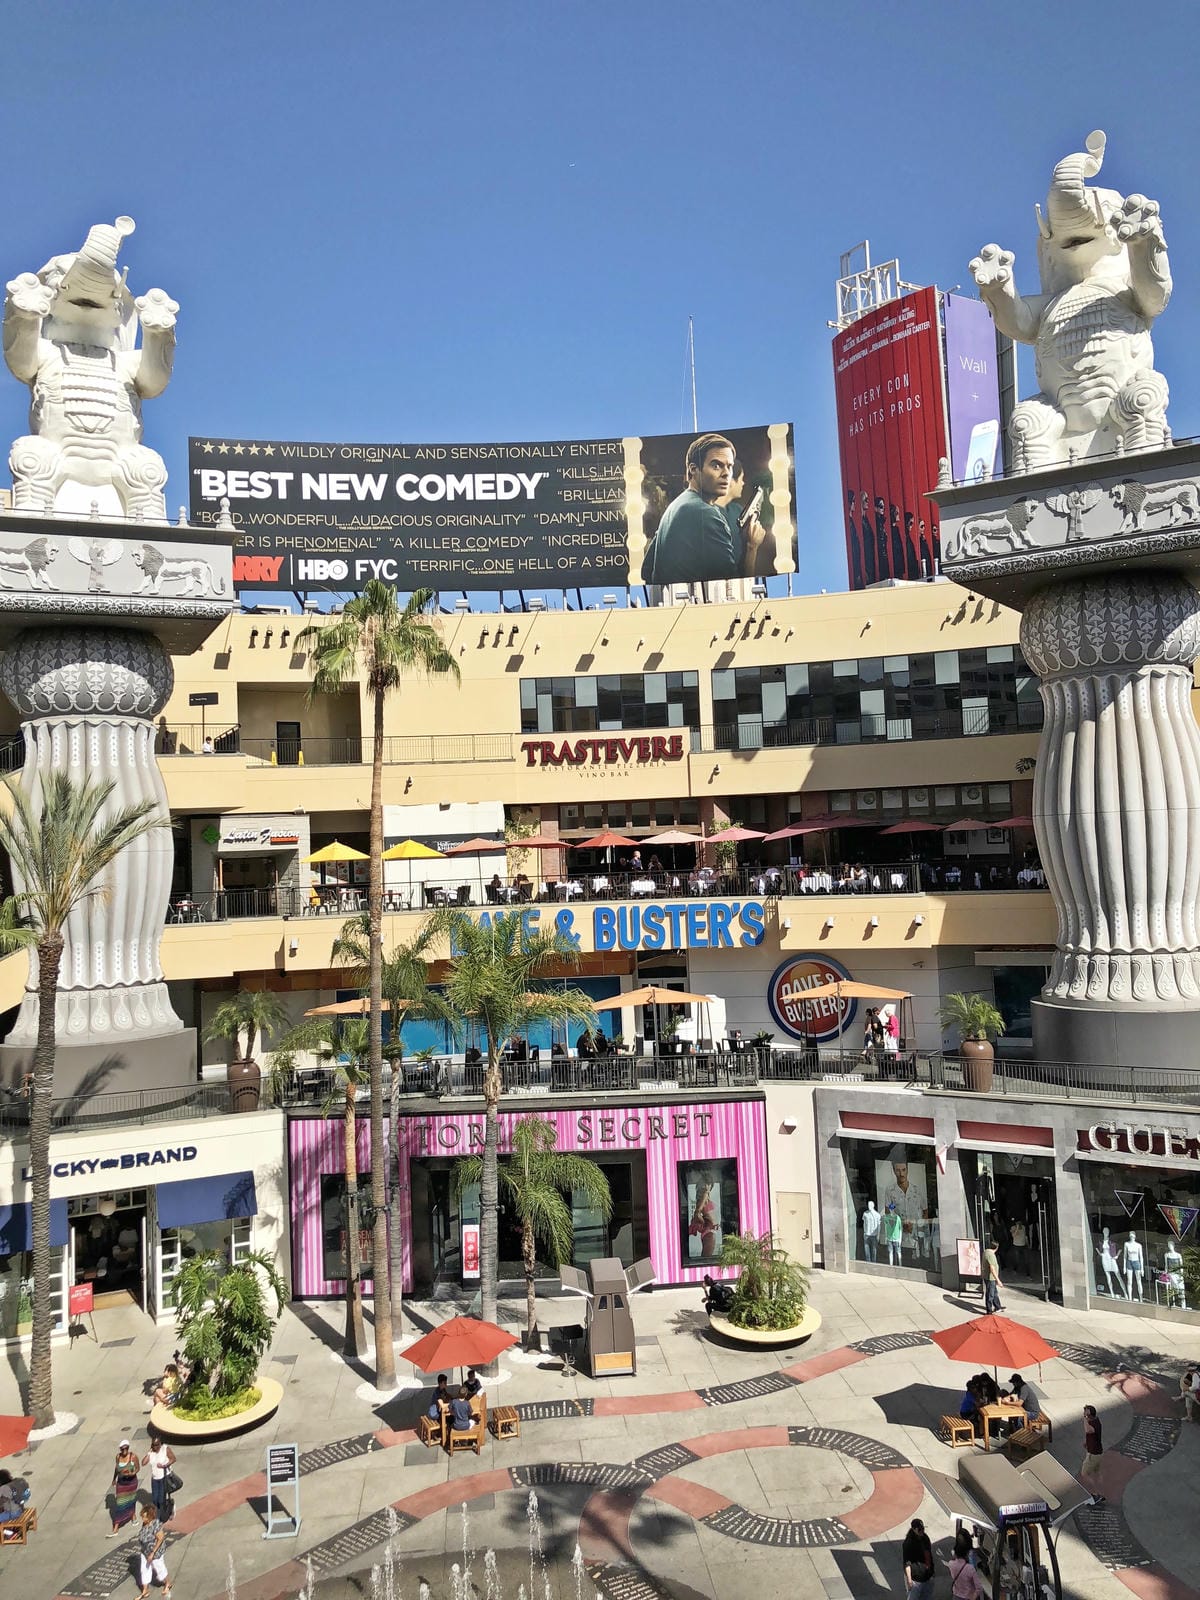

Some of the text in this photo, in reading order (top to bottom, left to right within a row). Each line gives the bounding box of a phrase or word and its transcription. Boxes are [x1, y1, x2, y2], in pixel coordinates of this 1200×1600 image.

[912, 321, 931, 334] CARTER
[959, 355, 987, 375] Wall
[853, 373, 909, 411] EVERY CON
[849, 394, 921, 437] HAS ITS PROS
[280, 446, 337, 459] WILDLY
[340, 446, 411, 459] ORIGINAL
[414, 448, 447, 459] AND
[450, 445, 566, 459] SENSATIONALLY
[556, 464, 624, 479] “KILLS...HA
[193, 469, 550, 501] “BEST NEW COMEDY”
[435, 514, 526, 526] ORIGINALITY”
[533, 511, 580, 525] “DAMN
[259, 536, 271, 548] IS
[275, 536, 382, 549] PHENOMENAL”
[389, 536, 534, 549] “A KILLER COMEDY”
[542, 532, 628, 547] “INCREDIBLY
[232, 555, 285, 582] RRY
[298, 559, 399, 581] HBO FYC
[518, 558, 554, 570] HELL
[557, 556, 577, 569] OF
[581, 556, 592, 568] A
[595, 554, 630, 567] SHO
[522, 735, 683, 766] TRASTEVERE
[556, 908, 581, 953] &
[594, 901, 765, 951] BUSTER'S
[576, 1112, 713, 1144] SECRET
[1089, 1120, 1200, 1160] GUE
[21, 1146, 198, 1181] LCKY BRAND
